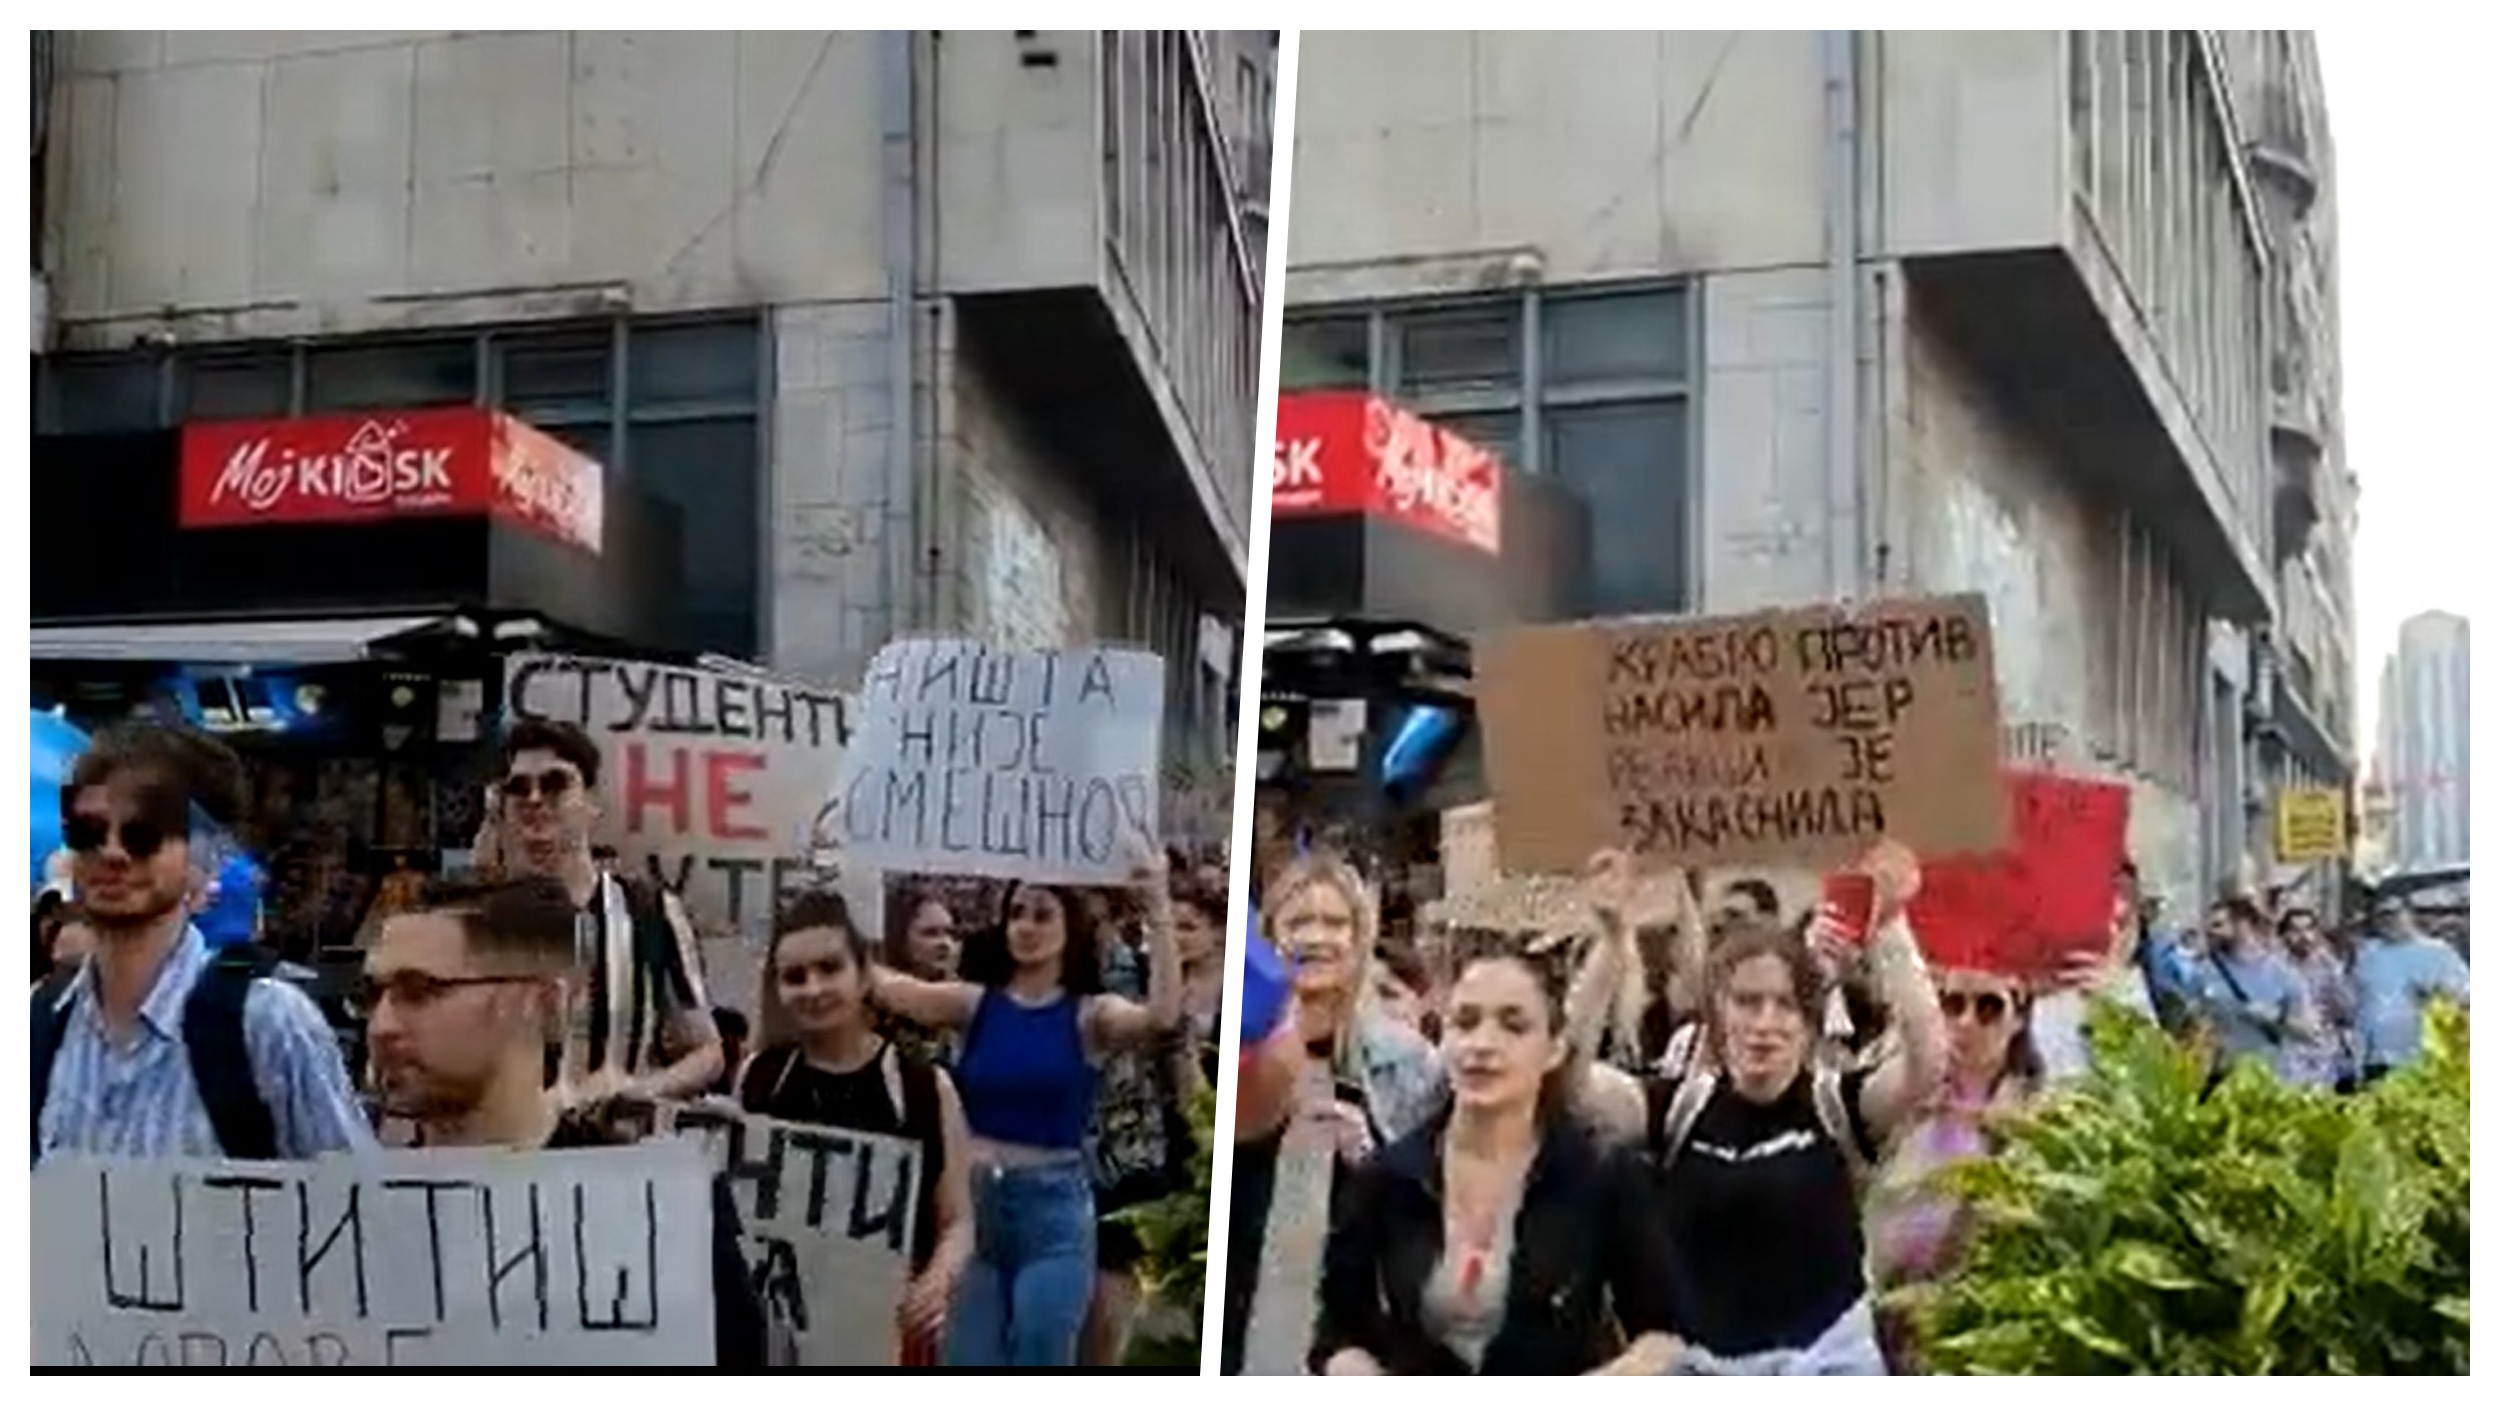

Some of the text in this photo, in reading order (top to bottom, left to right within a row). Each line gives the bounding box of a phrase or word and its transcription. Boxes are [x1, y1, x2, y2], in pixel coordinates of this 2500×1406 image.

[211, 438, 293, 508] Moj
[1799, 616, 1976, 672] ПРОТИВ
[900, 707, 1055, 773] НИЈЕ
[624, 745, 768, 839] НЕ
[674, 1110, 912, 1251] НТИ
[99, 1172, 657, 1332] ШТИТИШ
